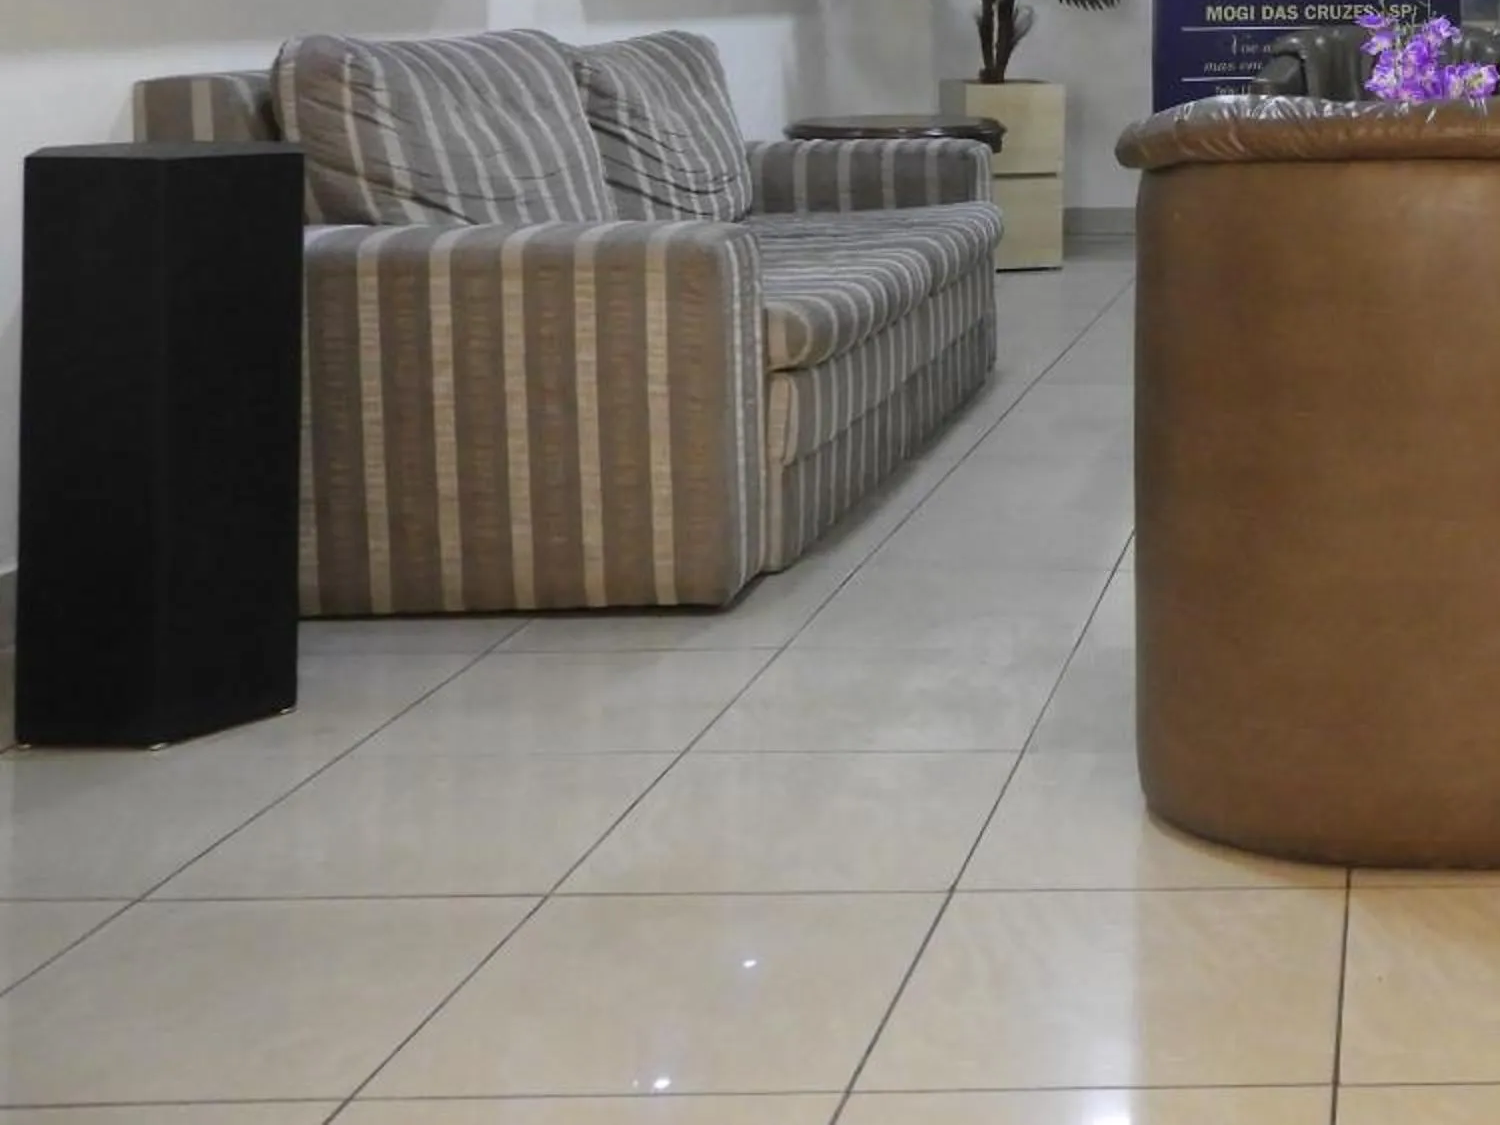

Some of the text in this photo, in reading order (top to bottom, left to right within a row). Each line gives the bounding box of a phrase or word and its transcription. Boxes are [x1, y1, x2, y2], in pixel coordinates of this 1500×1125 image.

[1205, 5, 1255, 22] MOGI
[1261, 4, 1299, 21] DAS
[1304, 3, 1376, 20] CRUZES
